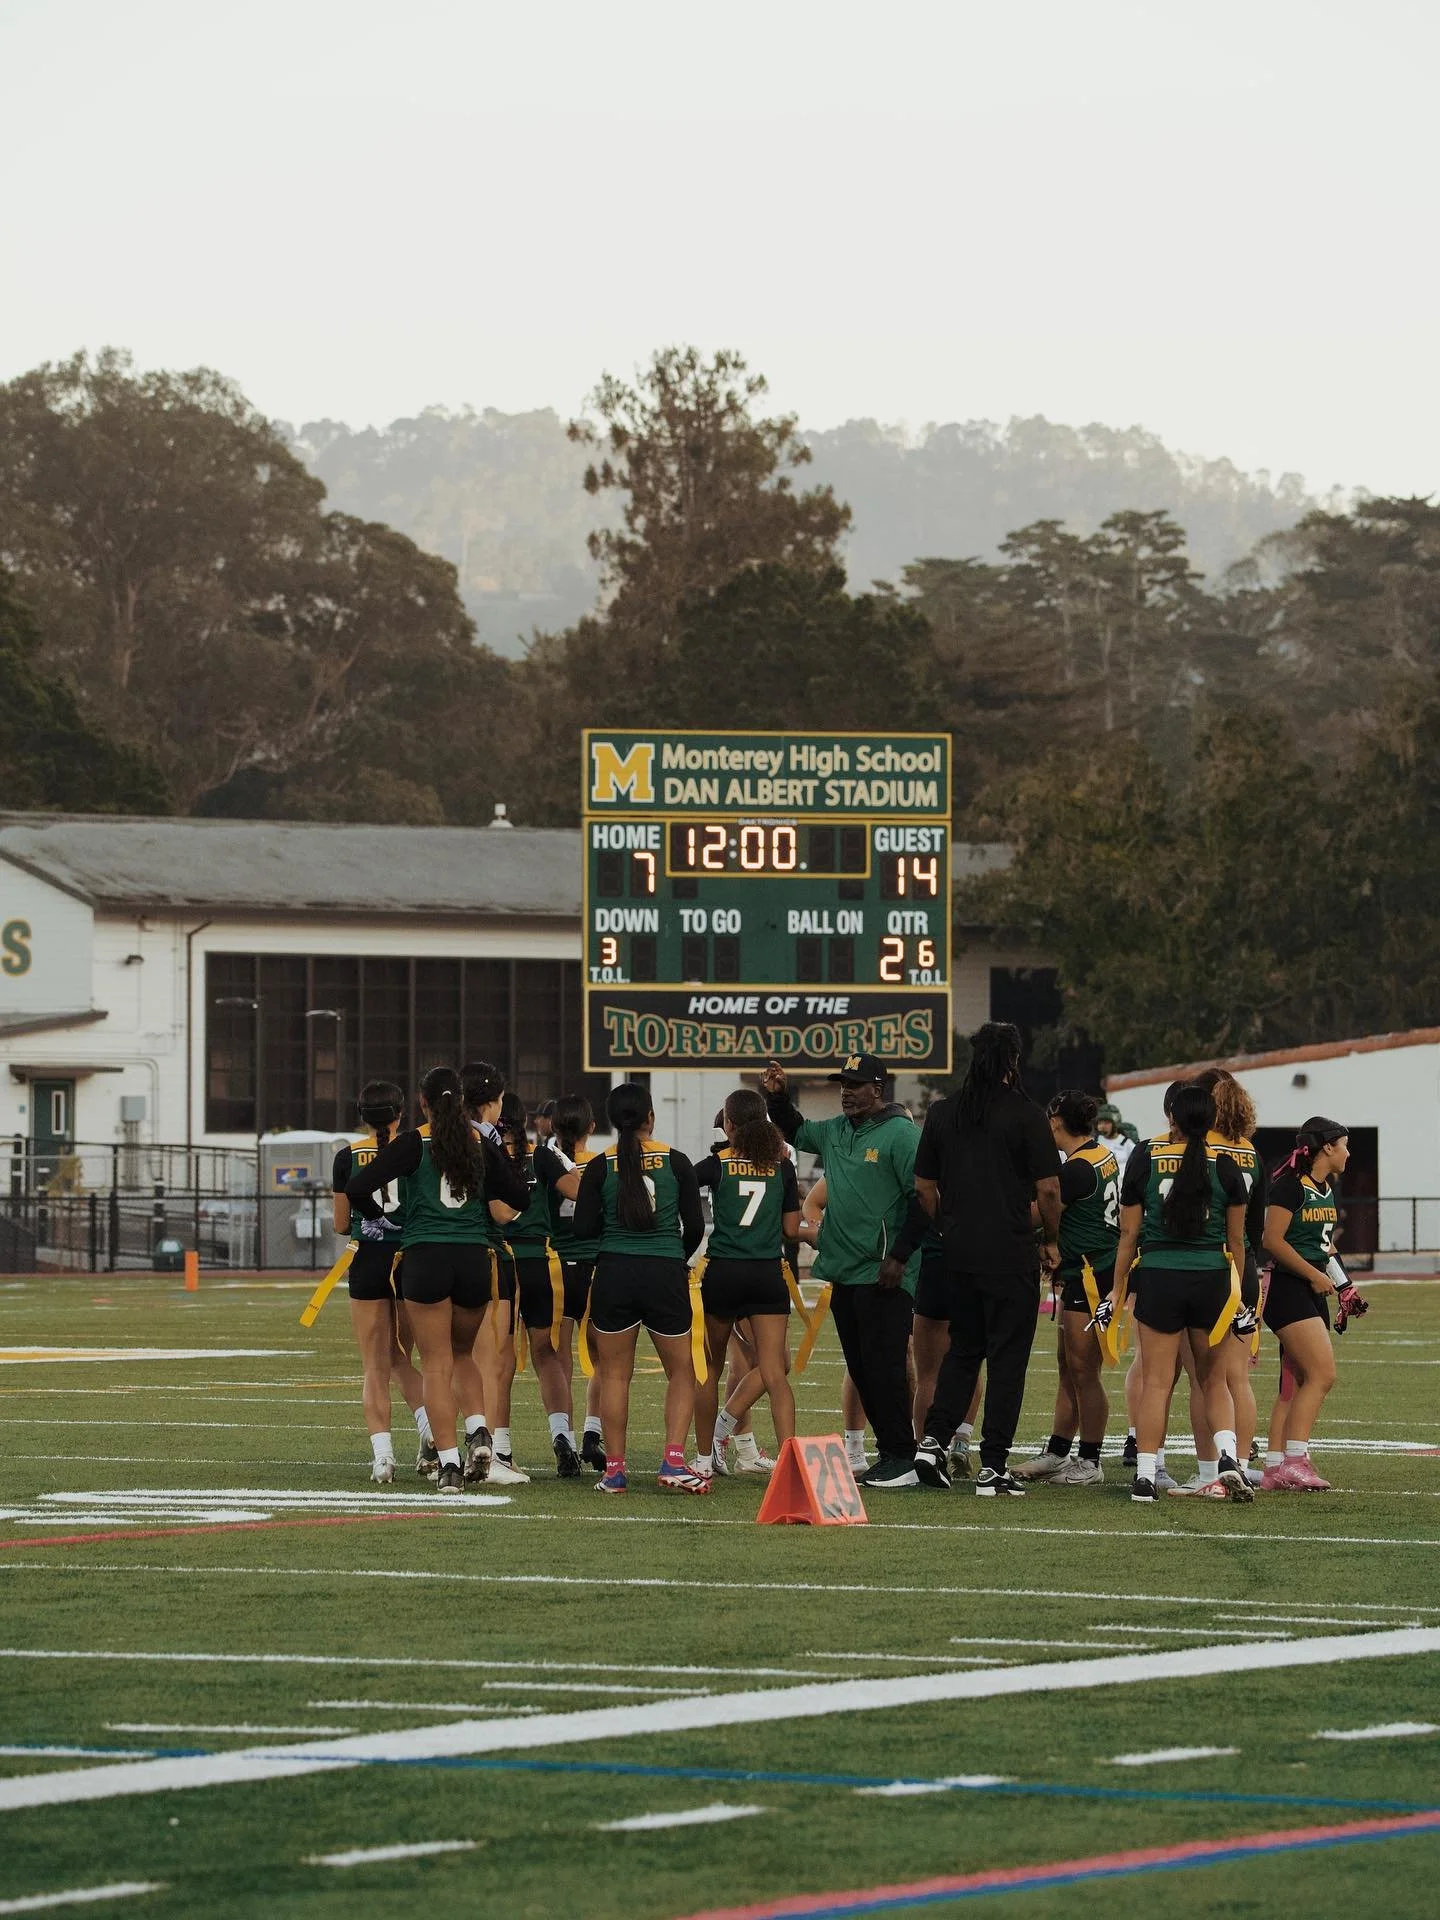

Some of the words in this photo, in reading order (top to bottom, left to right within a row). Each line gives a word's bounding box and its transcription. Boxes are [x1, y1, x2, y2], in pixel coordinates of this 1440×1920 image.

[591, 742, 655, 803] M
[662, 744, 785, 777] Monterey
[790, 745, 849, 777] High
[856, 745, 941, 773] School
[664, 779, 719, 804] DAN
[725, 779, 819, 805] ALBERT
[825, 780, 938, 807] STADIUM
[593, 825, 661, 849] HOME
[874, 828, 944, 852] GUEST
[633, 852, 656, 893] 7
[896, 857, 937, 895] 14
[595, 909, 659, 933] DOWN
[680, 909, 709, 933] TO
[712, 909, 741, 934] GO
[787, 911, 834, 934] BALL
[837, 911, 863, 934] ON
[887, 911, 929, 936] QTR
[601, 938, 617, 964] 3
[880, 938, 904, 981] 2
[918, 940, 935, 967] 6
[590, 967, 630, 983] T.O.L.
[909, 969, 948, 985] T.O.L.
[688, 997, 760, 1015] HOME
[765, 997, 800, 1015] OF
[805, 997, 849, 1015] THE
[604, 1006, 933, 1059] TOREADORES
[845, 1056, 862, 1071] M
[864, 1148, 879, 1163] M
[739, 1180, 766, 1227] 7
[1319, 1222, 1334, 1254] 5
[805, 1442, 862, 1518] 20
